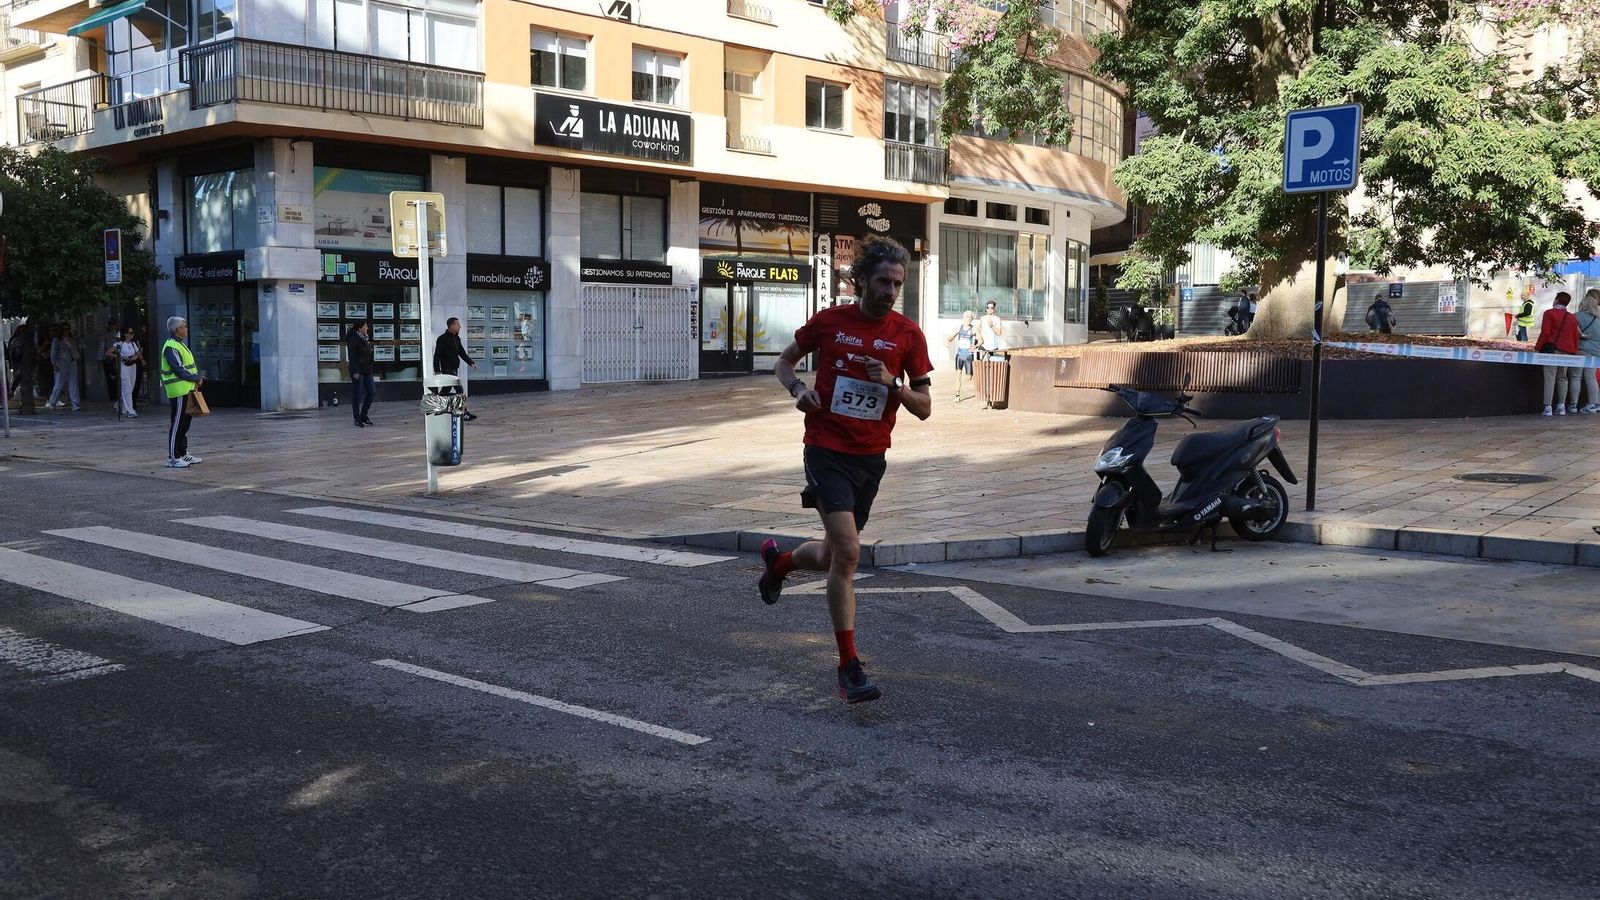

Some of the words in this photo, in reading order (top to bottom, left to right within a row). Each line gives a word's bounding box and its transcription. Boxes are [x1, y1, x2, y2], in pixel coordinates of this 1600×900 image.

[599, 109, 617, 134] LA
[623, 113, 680, 142] ADUANA
[632, 139, 680, 155] coworking
[1288, 116, 1335, 183] P
[1310, 167, 1351, 183] MOTOS
[737, 210, 775, 220] APARTAMENTOS
[867, 202, 882, 217] SOLE
[866, 217, 891, 232] HUNTERS
[179, 266, 203, 279] PARQUE
[379, 268, 419, 280] PARQU
[581, 268, 624, 277] GESTIONAMOS
[626, 269, 634, 277] SU
[636, 270, 671, 279] PATRIMONIO
[737, 268, 766, 279] PARQUE
[770, 267, 799, 281] FLATS
[842, 390, 878, 409] 573
[1200, 497, 1222, 516] YAMAHA
